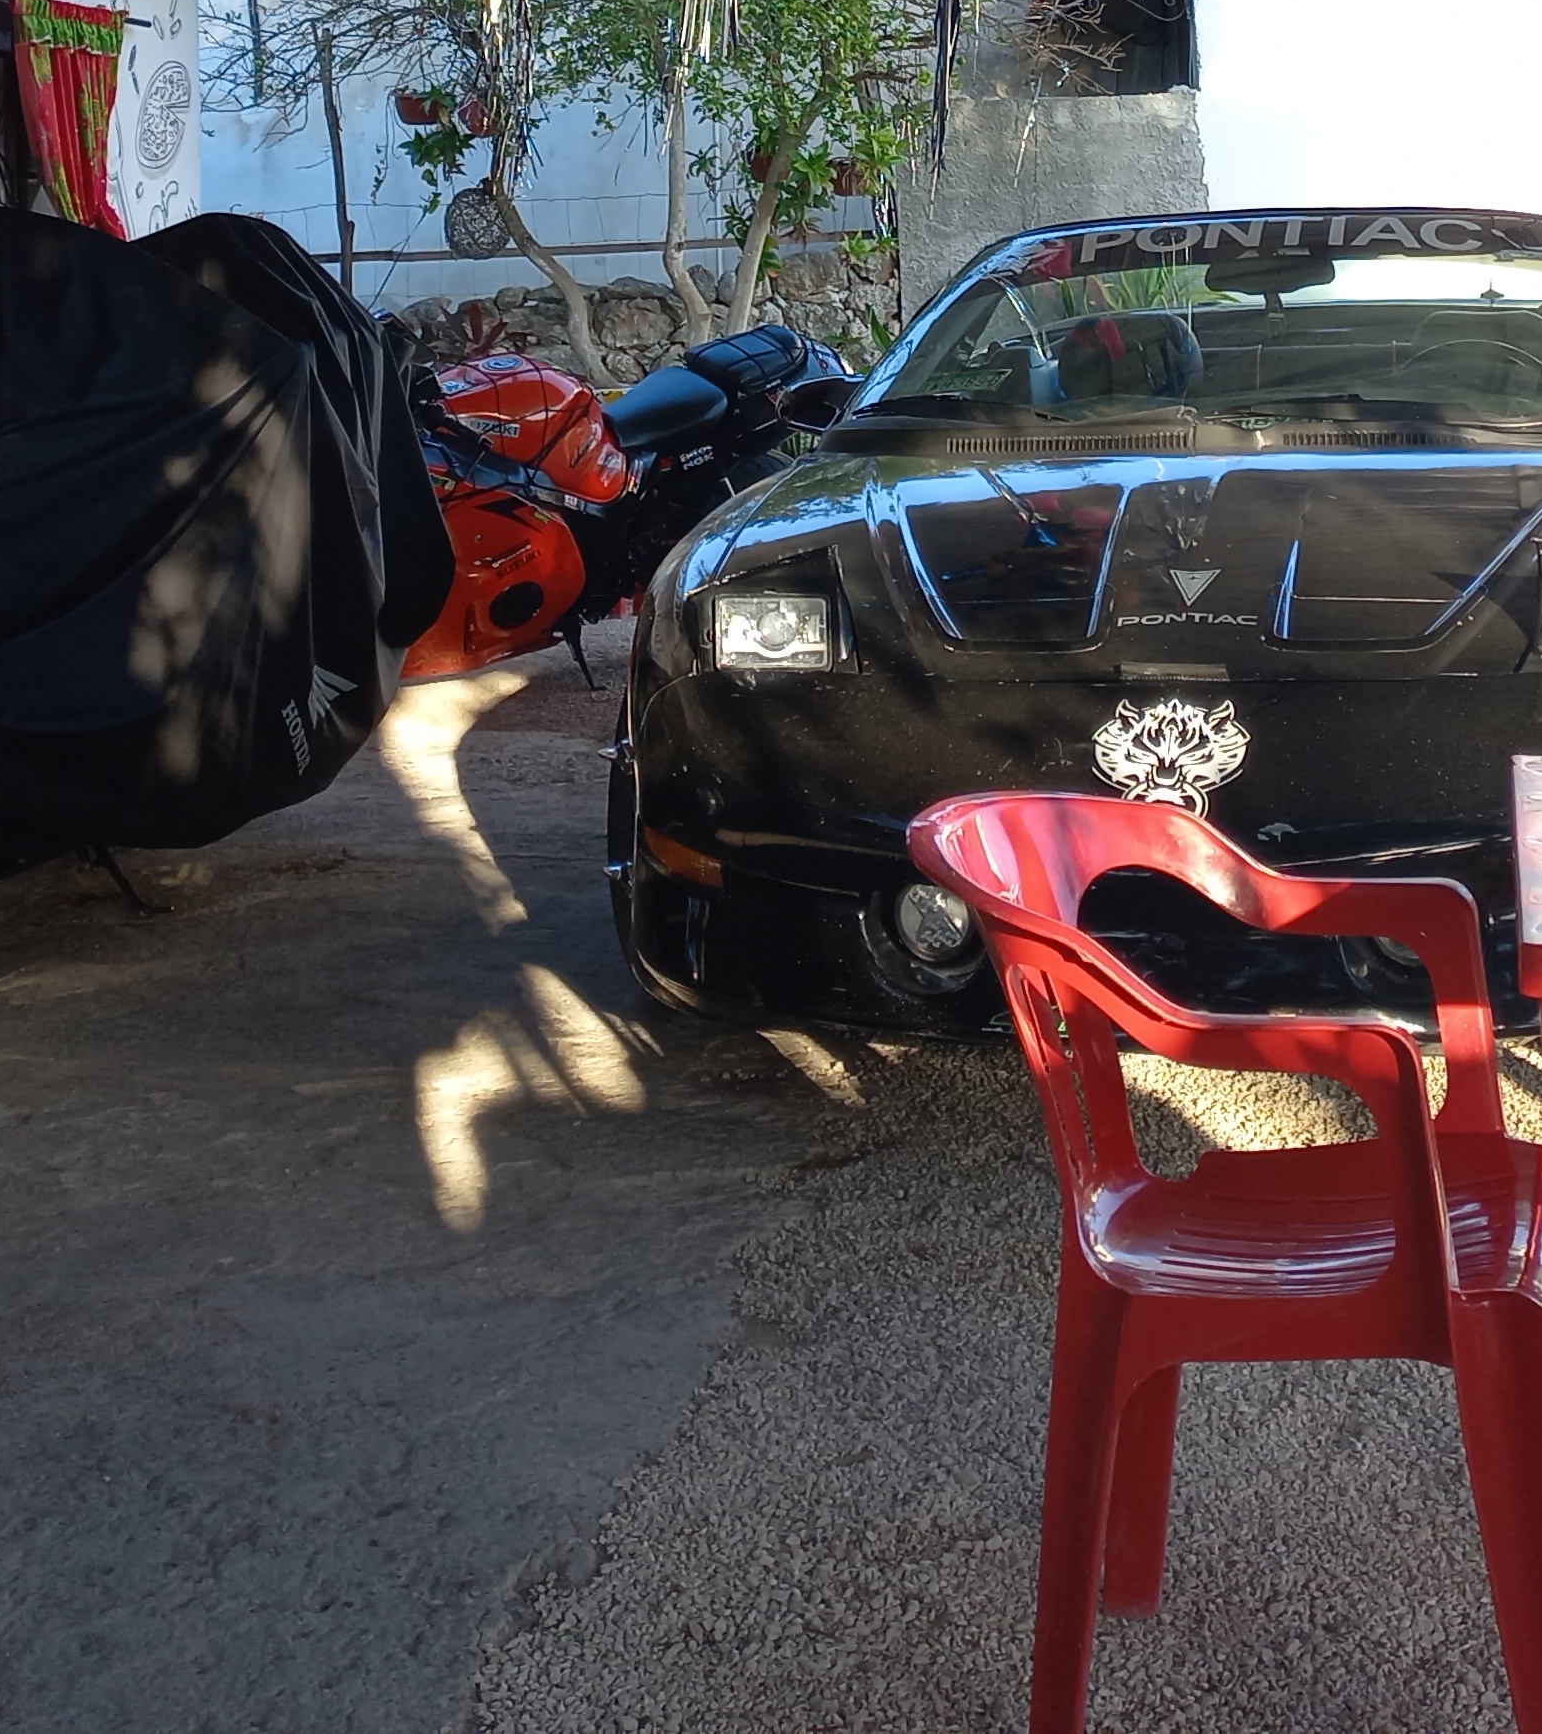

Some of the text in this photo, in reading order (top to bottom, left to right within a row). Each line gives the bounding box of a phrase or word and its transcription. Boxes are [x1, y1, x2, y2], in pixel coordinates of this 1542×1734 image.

[1080, 216, 1484, 264] PONTIAC
[1117, 612, 1258, 627] PONTIAC
[281, 698, 311, 777] HONDA
